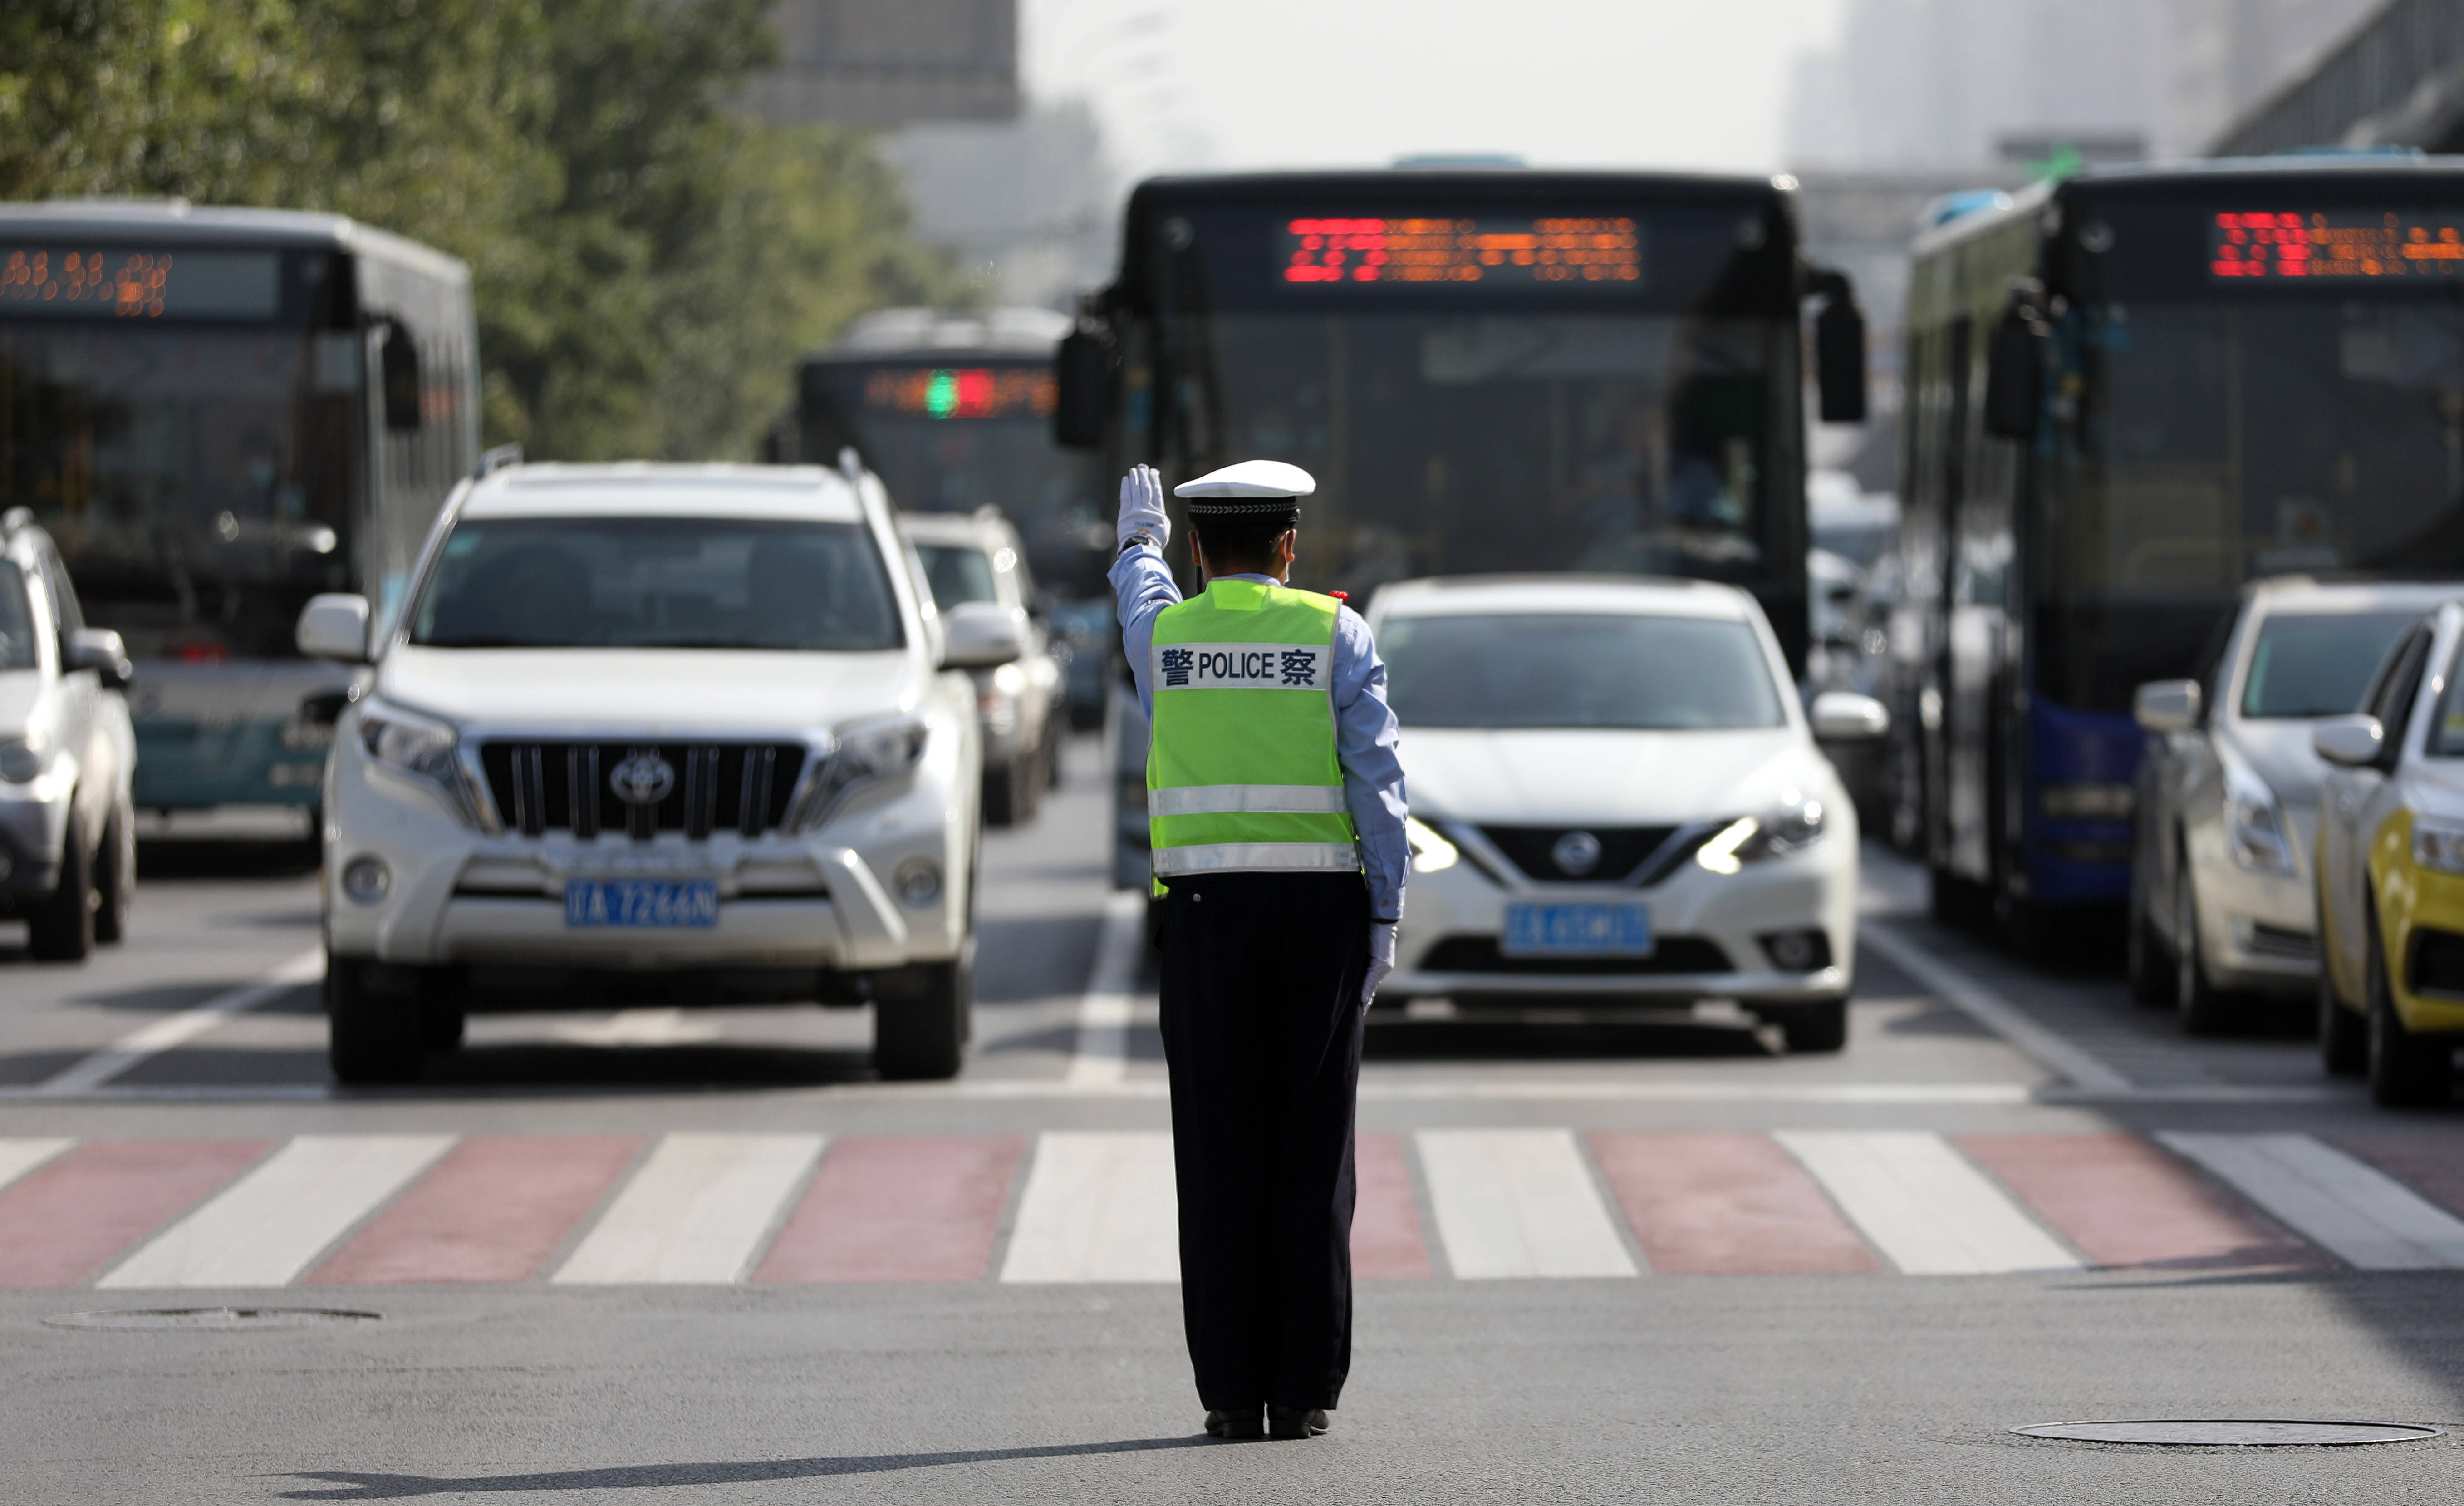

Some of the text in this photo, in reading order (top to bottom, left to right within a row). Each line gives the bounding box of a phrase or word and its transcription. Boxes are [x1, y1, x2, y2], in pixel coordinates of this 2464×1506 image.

[1161, 648, 1316, 687] 警 POLICE 察
